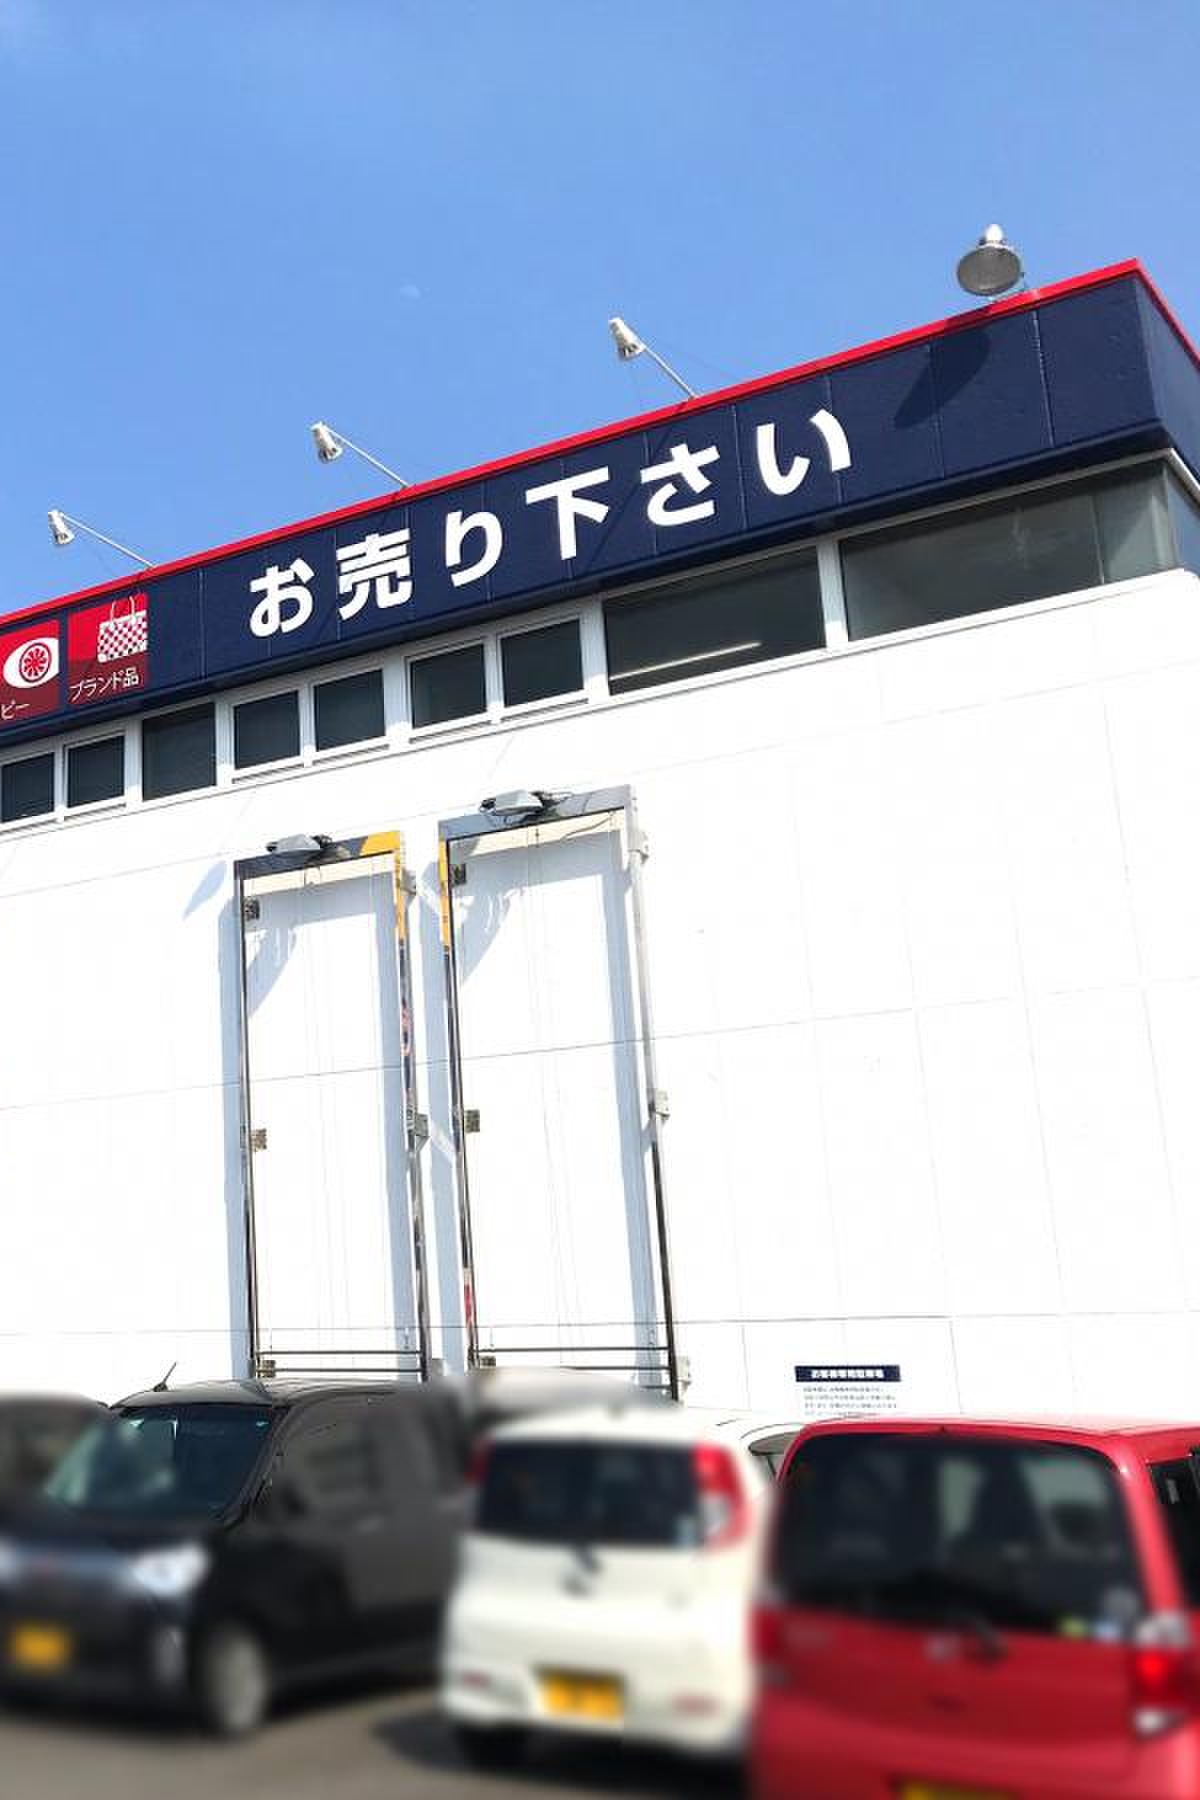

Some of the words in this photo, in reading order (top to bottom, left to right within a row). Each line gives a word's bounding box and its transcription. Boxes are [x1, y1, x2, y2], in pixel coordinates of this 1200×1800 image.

[248, 408, 852, 638] お売り下さい
[69, 667, 140, 703] ブランド品
